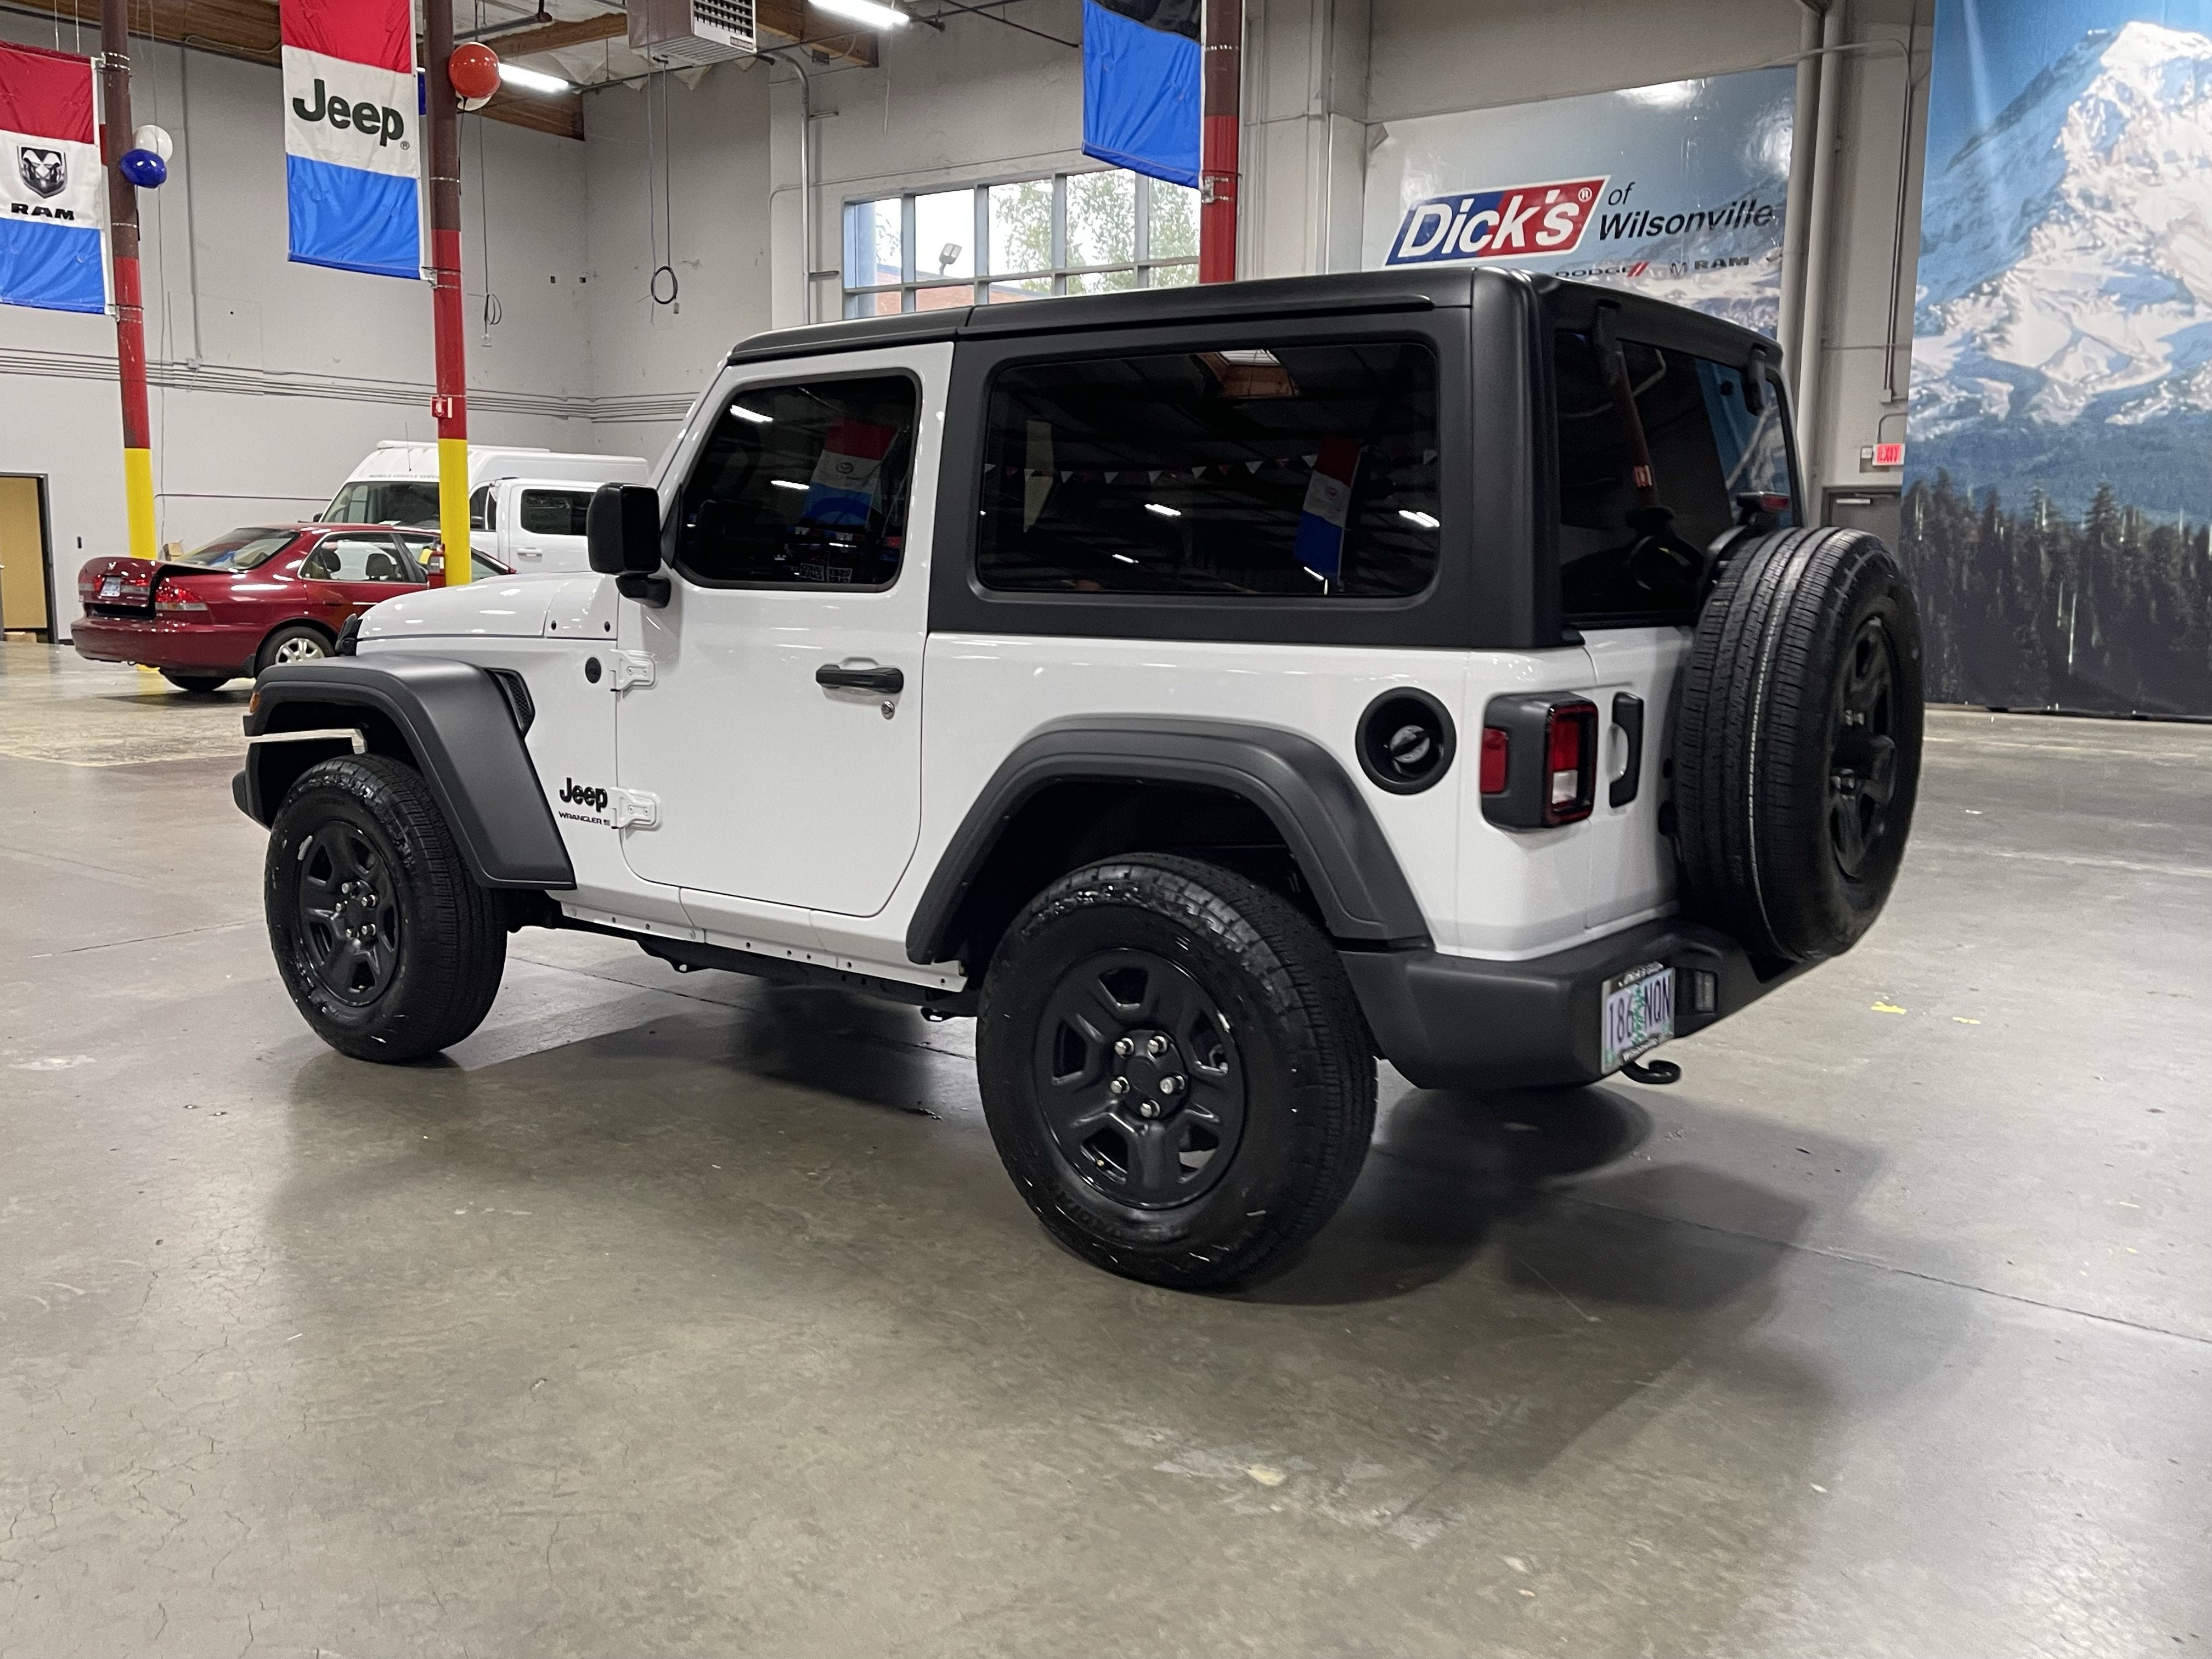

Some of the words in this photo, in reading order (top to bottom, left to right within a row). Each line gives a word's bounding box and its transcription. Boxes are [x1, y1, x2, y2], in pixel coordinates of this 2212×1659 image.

[293, 78, 404, 147] Jeep
[1608, 182, 1634, 206] of
[11, 202, 75, 221] RAM
[1397, 189, 1580, 258] Dick's
[1599, 198, 1774, 241] Wilsonville
[1694, 256, 1750, 270] RAM
[1878, 445, 1900, 463] EXIT
[559, 777, 608, 812] Jeep
[558, 811, 602, 825] WRANGLER
[1610, 994, 1634, 1049] 186
